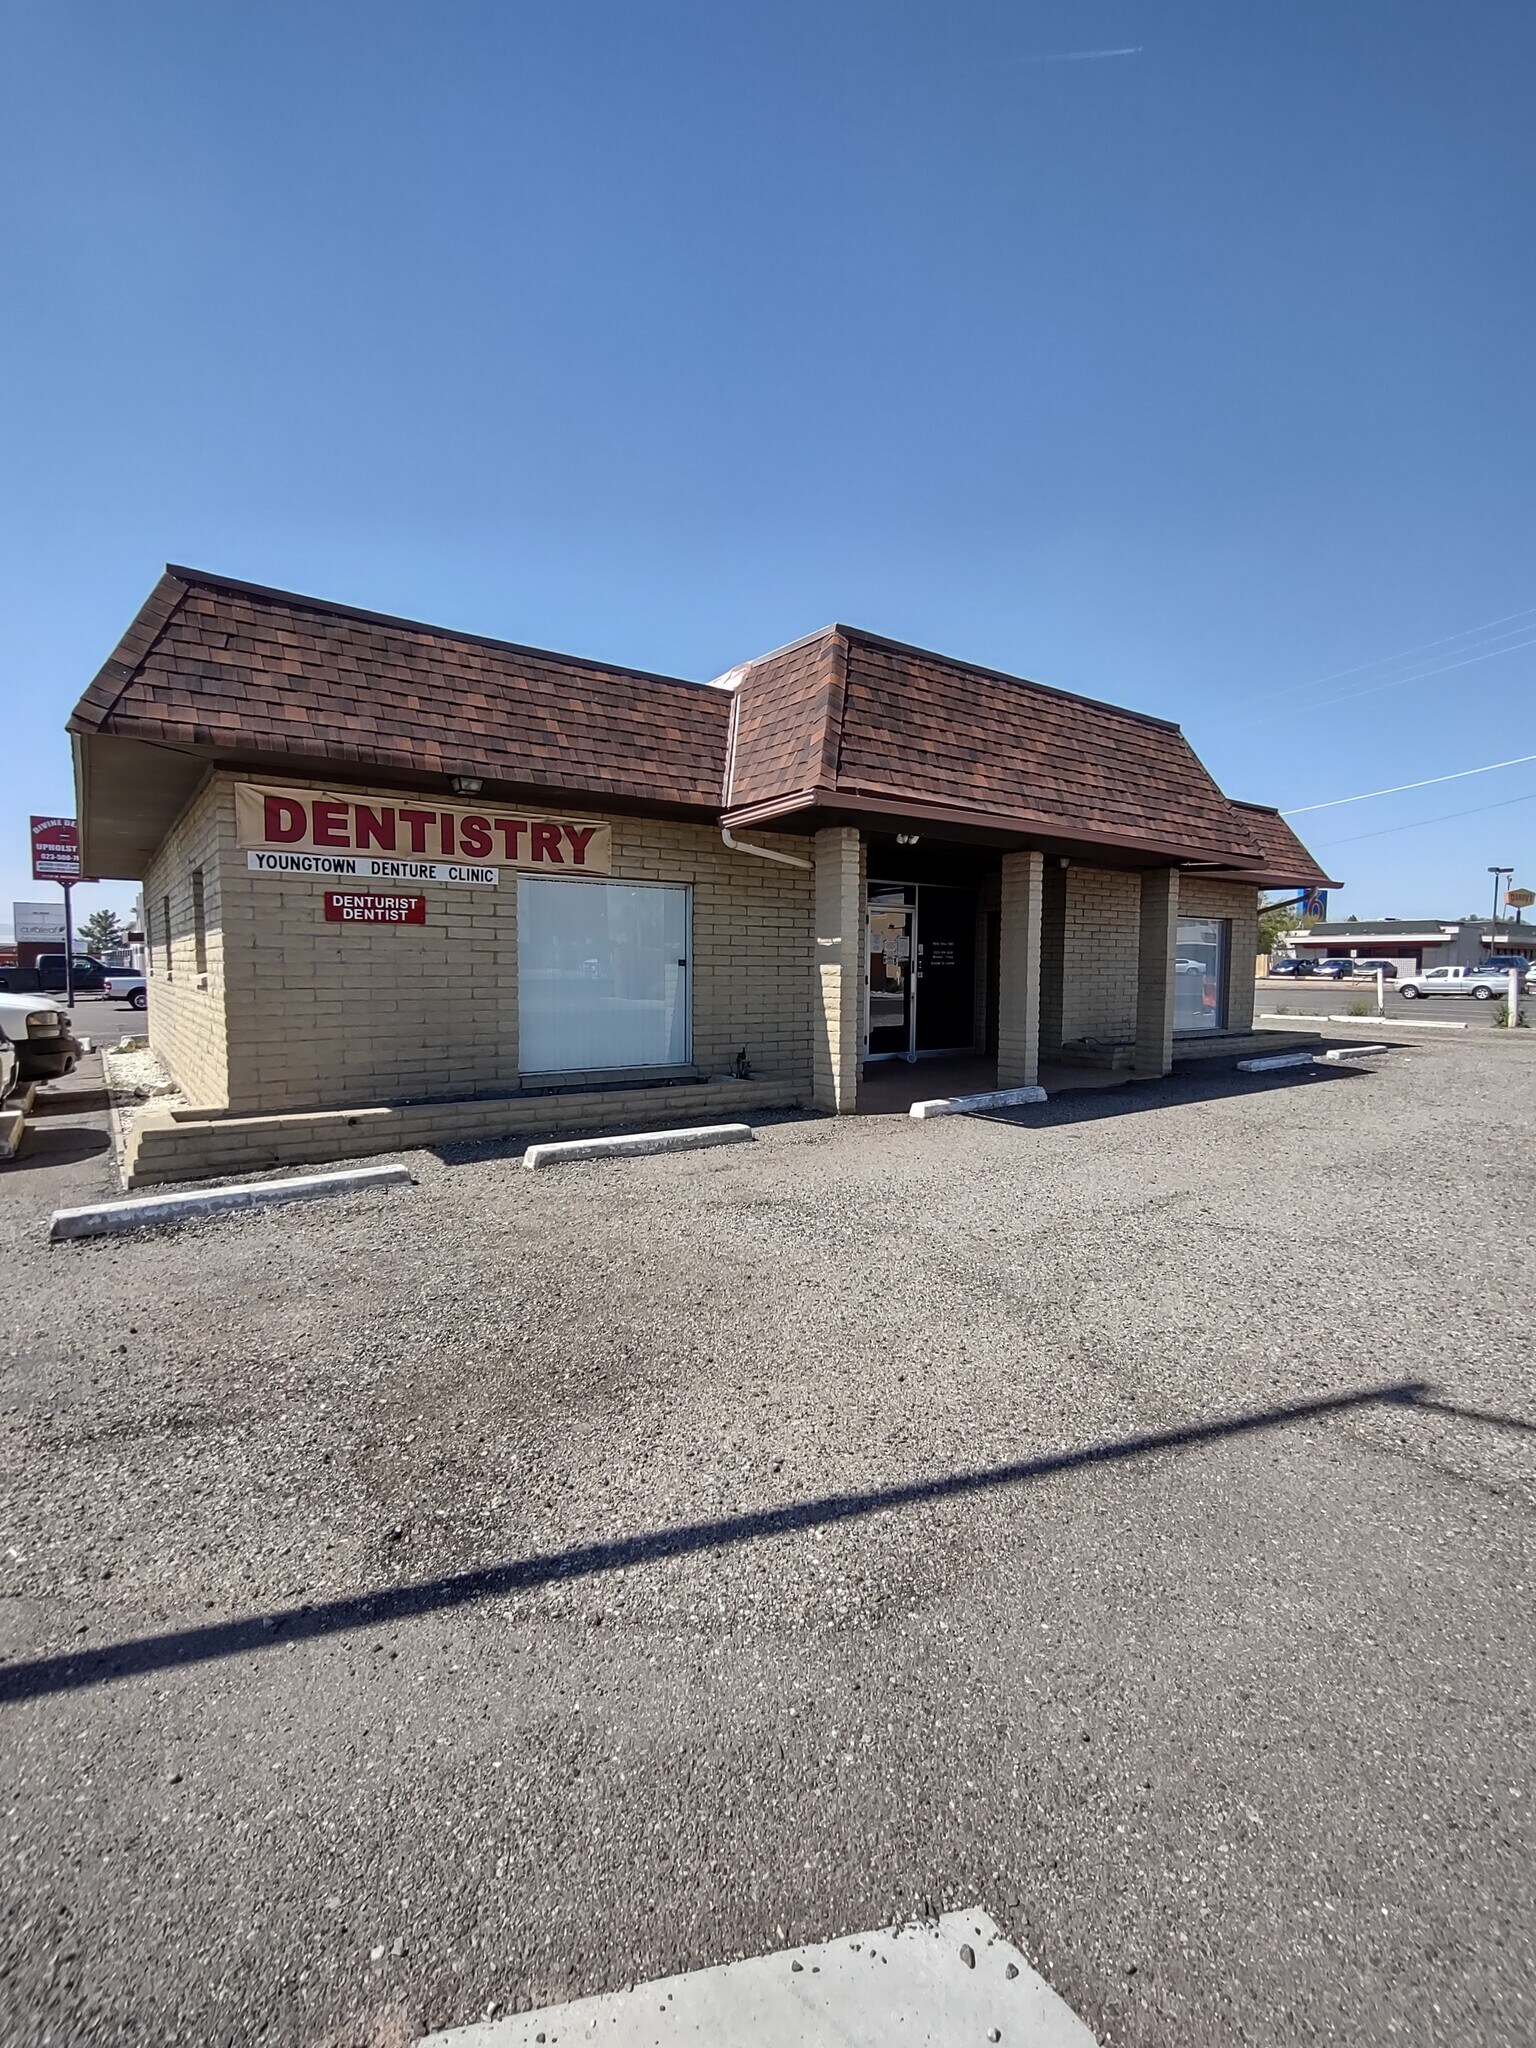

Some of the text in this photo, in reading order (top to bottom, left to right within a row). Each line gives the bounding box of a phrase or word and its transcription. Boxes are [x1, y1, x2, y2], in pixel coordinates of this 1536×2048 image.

[264, 796, 596, 865] DENTISTRY
[256, 853, 494, 883] YOUNGTOWN DENTURE CLINIC
[332, 895, 418, 909] DENTURIST
[343, 908, 408, 922] DENTIST
